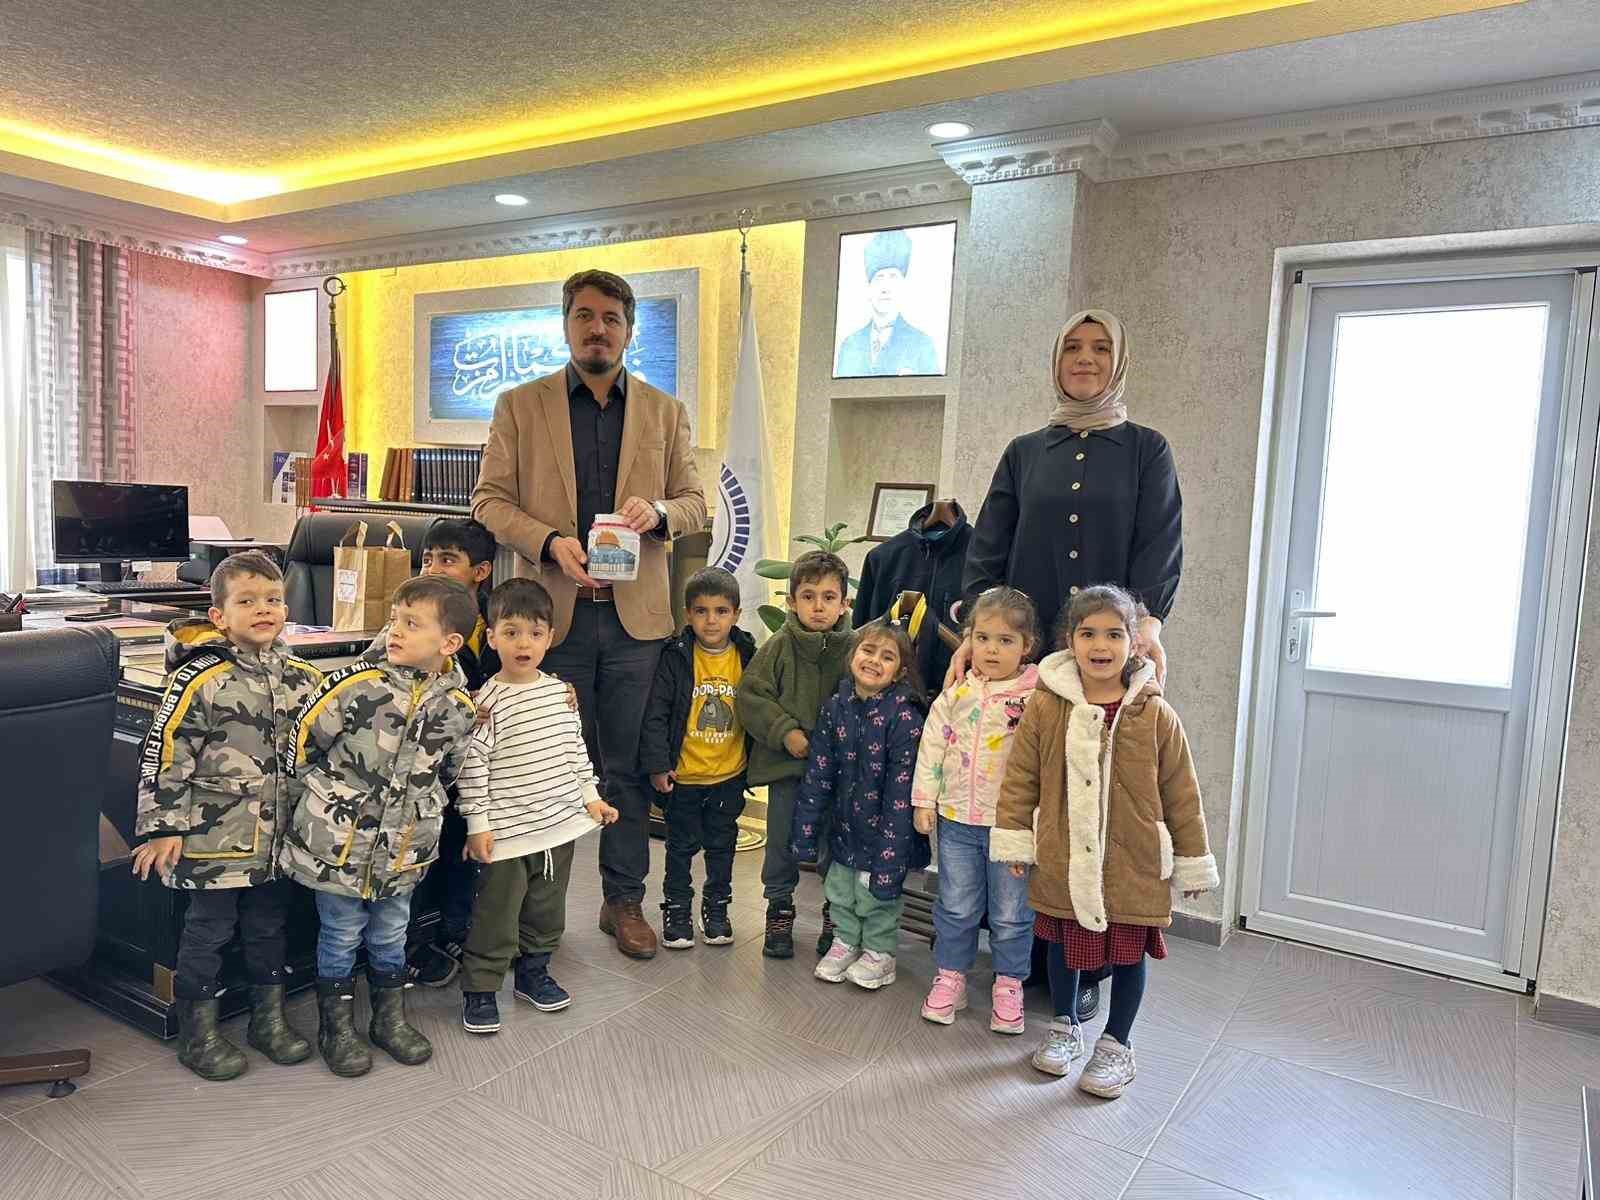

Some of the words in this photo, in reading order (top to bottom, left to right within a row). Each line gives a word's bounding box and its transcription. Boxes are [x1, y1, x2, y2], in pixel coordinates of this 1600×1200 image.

[192, 654, 221, 670] RUN
[351, 661, 379, 672] UN
[177, 668, 198, 682] TO
[332, 668, 350, 681] TO
[171, 682, 183, 694] A
[323, 677, 331, 691] A
[150, 694, 179, 740] BRIGHT
[141, 740, 161, 784] FUTURE
